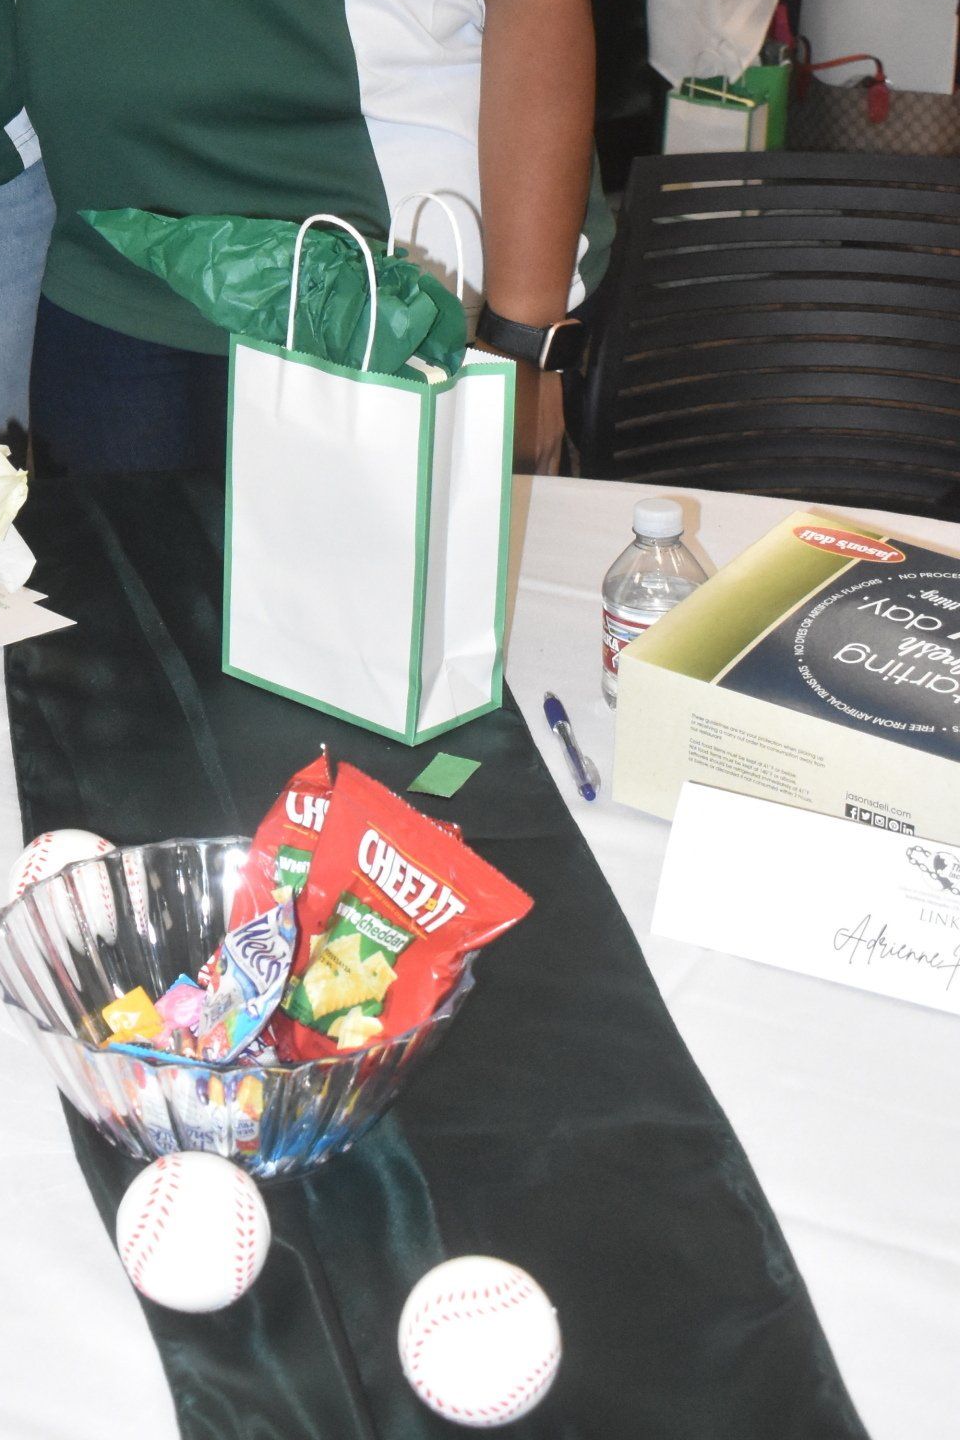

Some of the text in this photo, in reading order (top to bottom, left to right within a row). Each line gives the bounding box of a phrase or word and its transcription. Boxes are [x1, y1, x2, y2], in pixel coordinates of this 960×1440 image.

[799, 529, 898, 561] Jason's deli
[898, 572, 917, 580] NO
[794, 578, 883, 656] NO DYES OR ARTIFICIAL FLAVORS
[857, 595, 943, 630] day.
[798, 665, 812, 681] FATS
[807, 677, 829, 699] TRANS
[827, 695, 873, 725] ARTIFICIAL
[873, 716, 907, 730] FROM
[909, 722, 935, 733] FREE
[845, 790, 912, 819] jasonsdeli.com
[358, 917, 405, 950] cheddar
[833, 913, 944, 967] Adrienne
